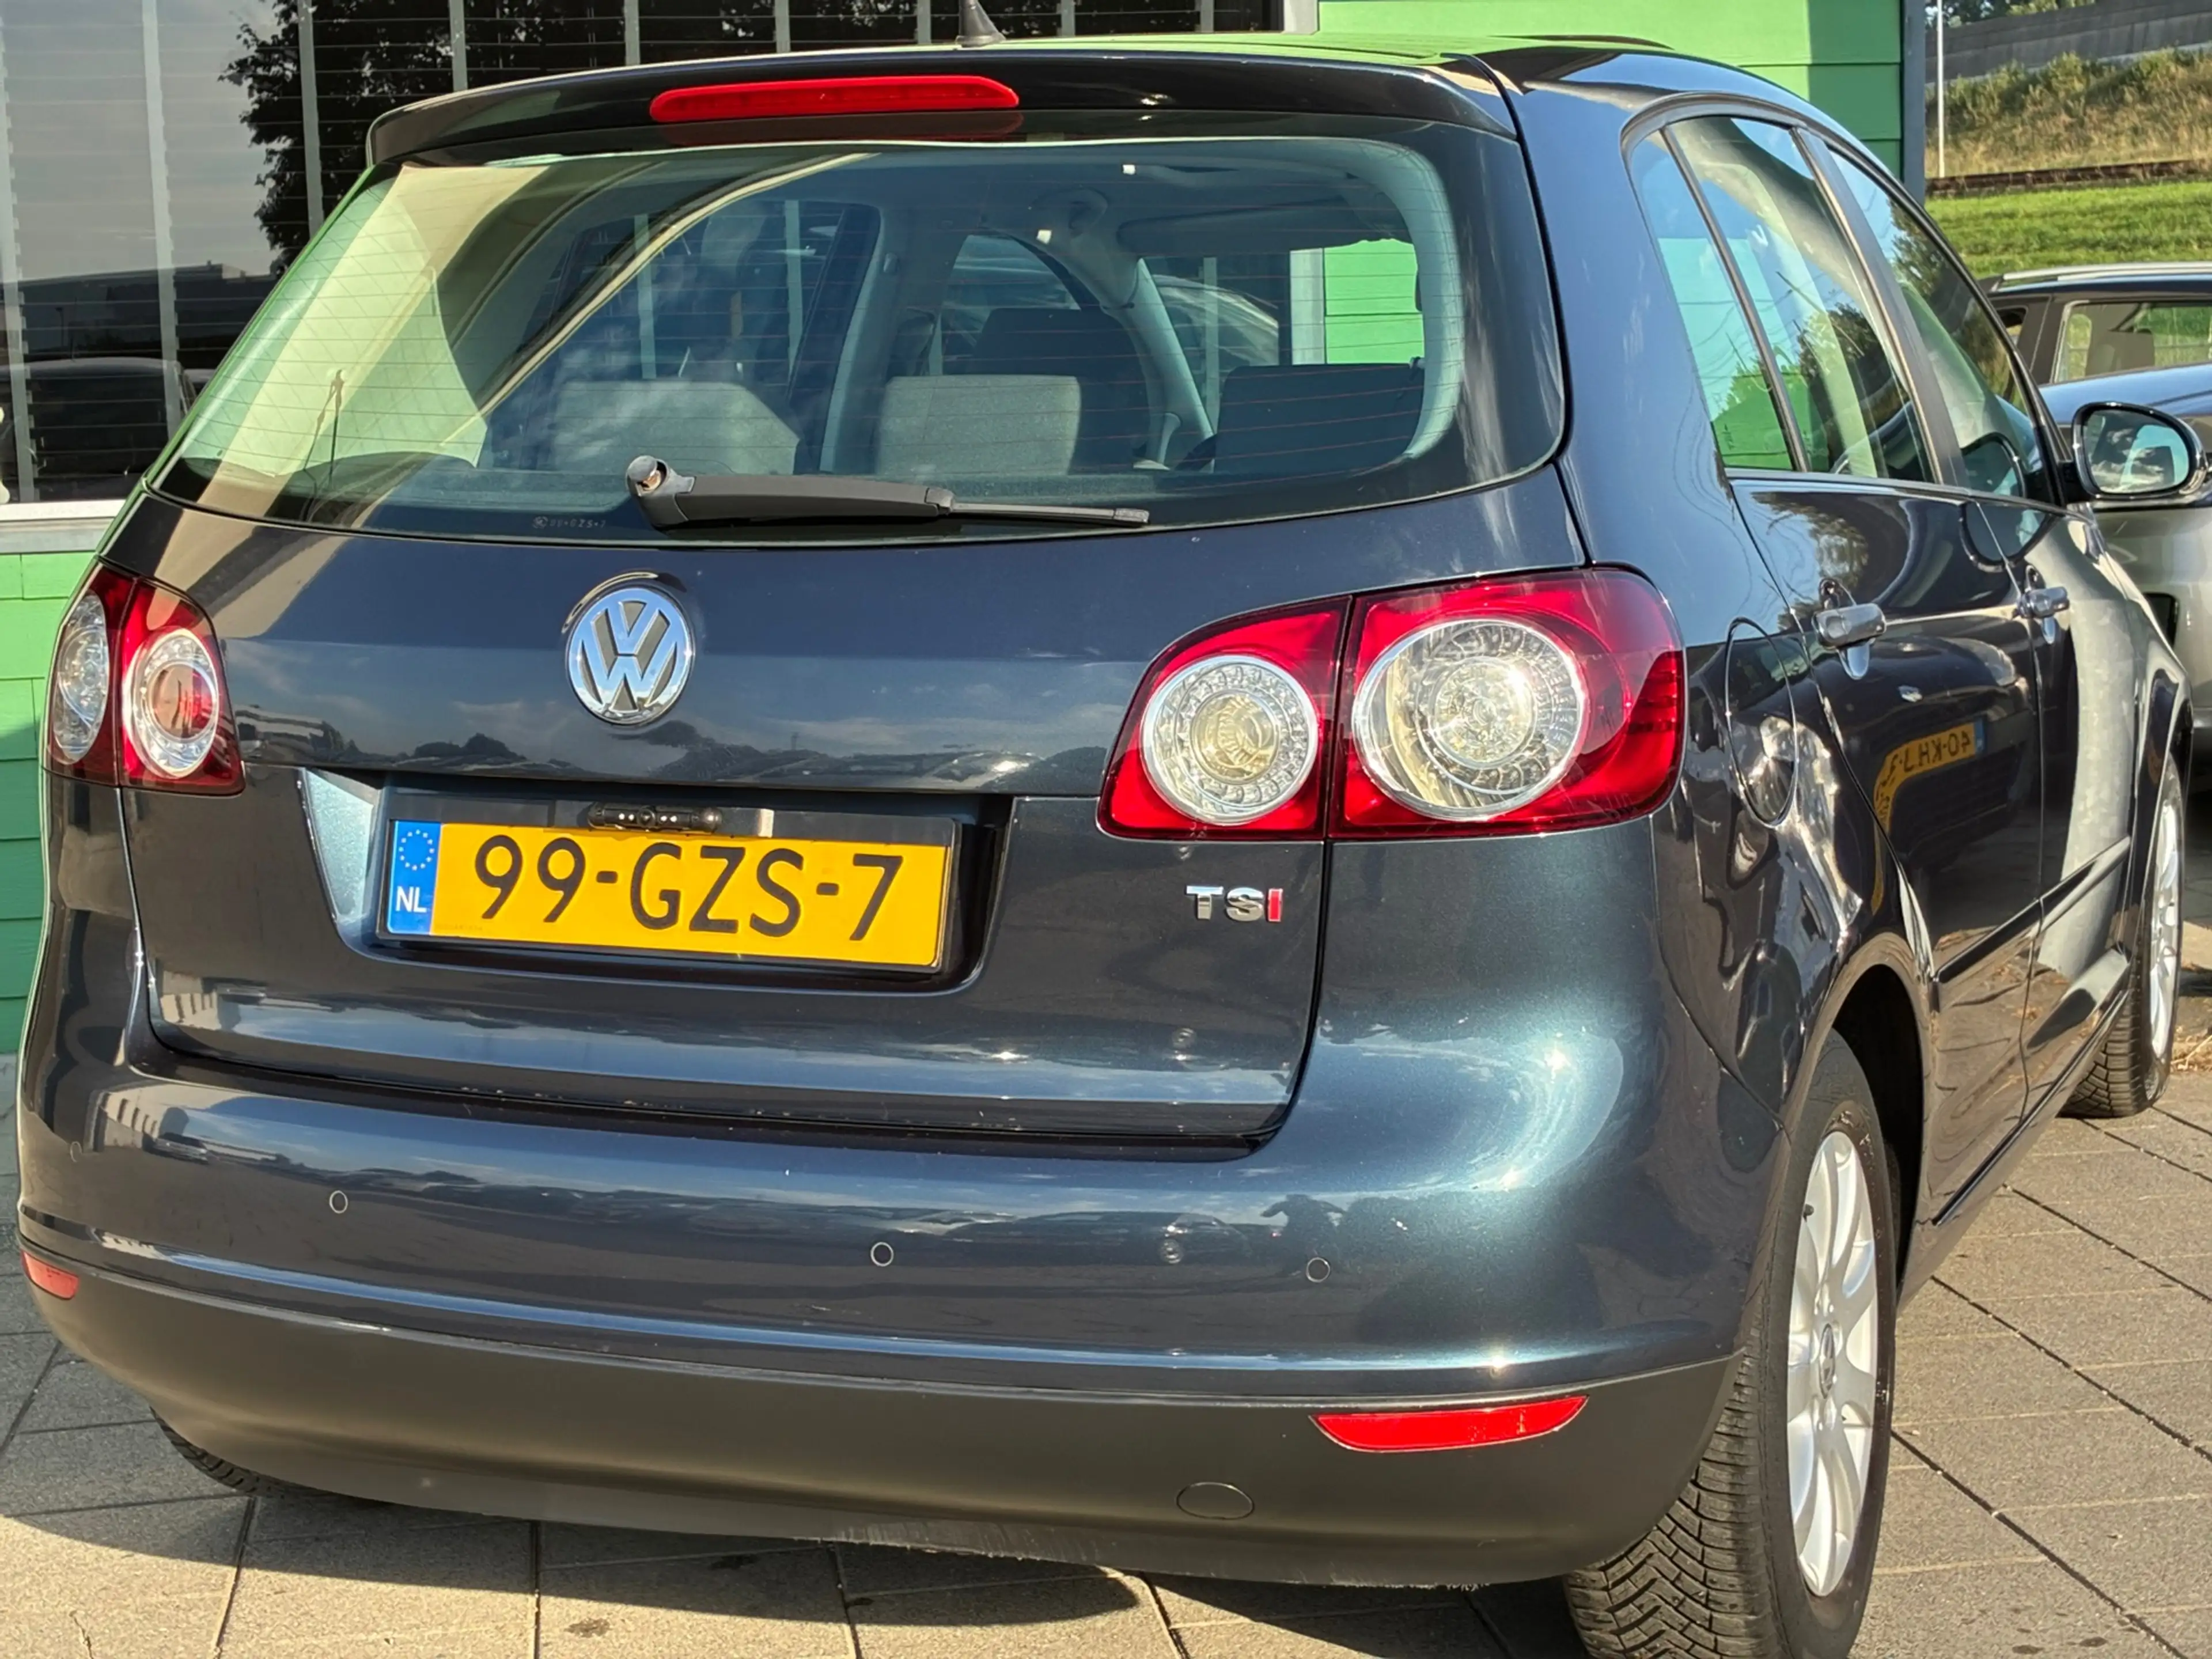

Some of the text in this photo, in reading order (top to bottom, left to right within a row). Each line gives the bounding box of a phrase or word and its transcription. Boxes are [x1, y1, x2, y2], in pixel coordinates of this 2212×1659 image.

[396, 887, 427, 913] NL
[474, 834, 904, 941] 99-GZS-7
[1185, 885, 1283, 922] TSI
